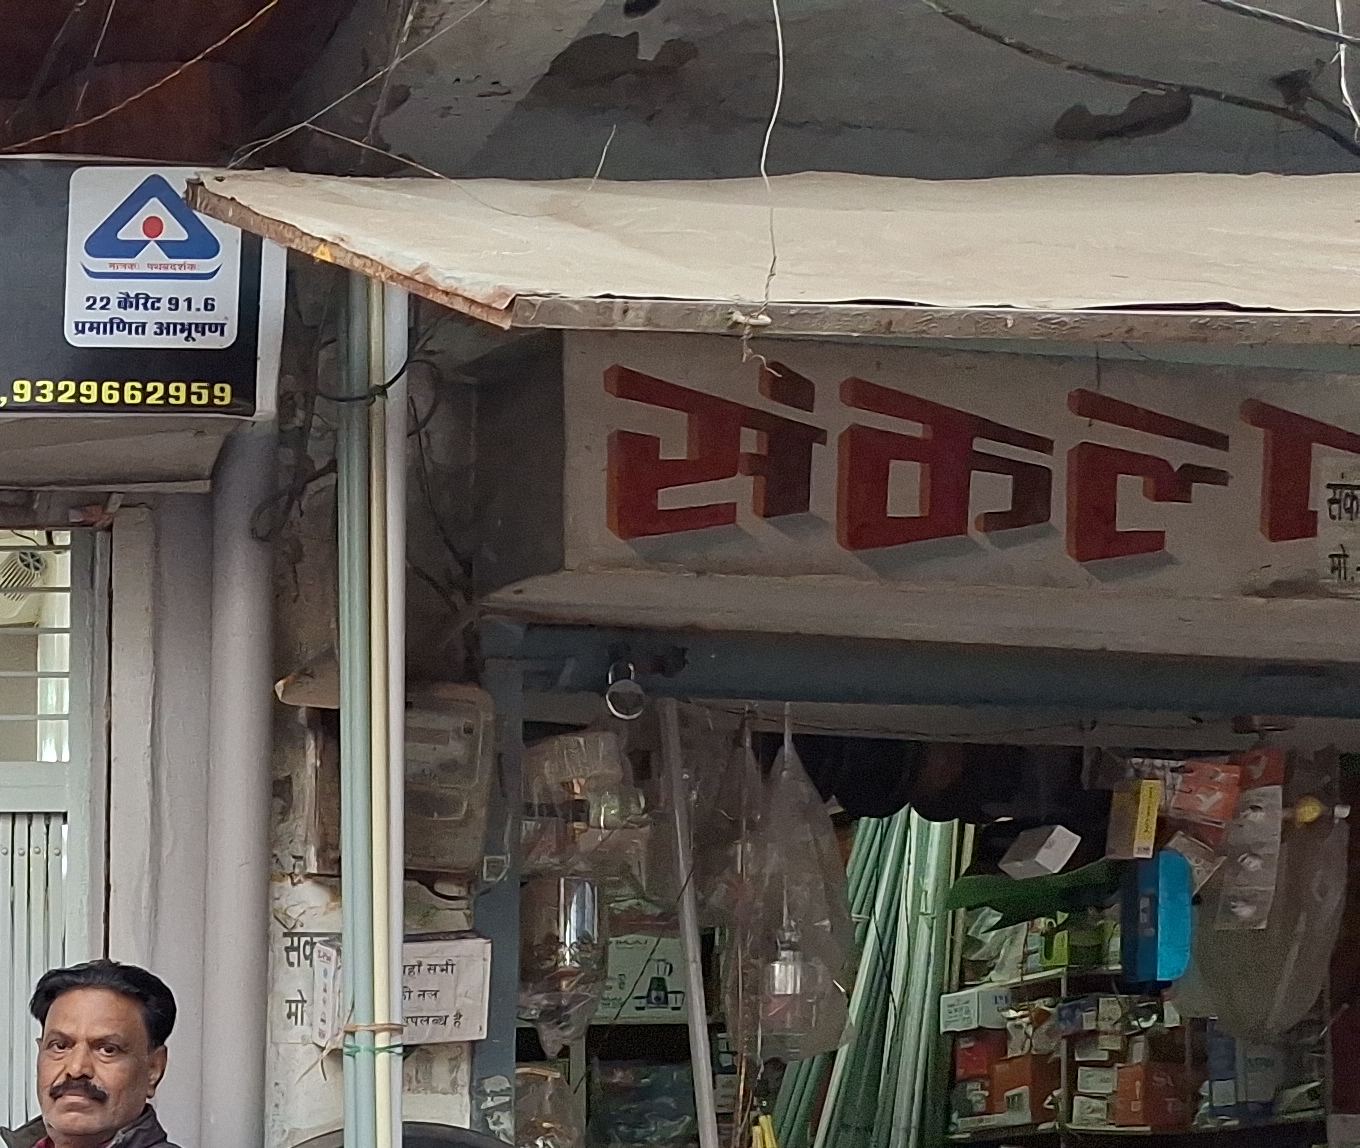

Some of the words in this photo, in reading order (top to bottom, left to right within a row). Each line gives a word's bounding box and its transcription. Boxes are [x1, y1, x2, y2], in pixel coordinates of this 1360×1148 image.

[85, 296, 112, 312] 22
[117, 292, 163, 312] कैरिट
[167, 297, 216, 313] 91.6
[73, 317, 148, 337] प्रमाणित
[153, 321, 227, 342] आभूषण
